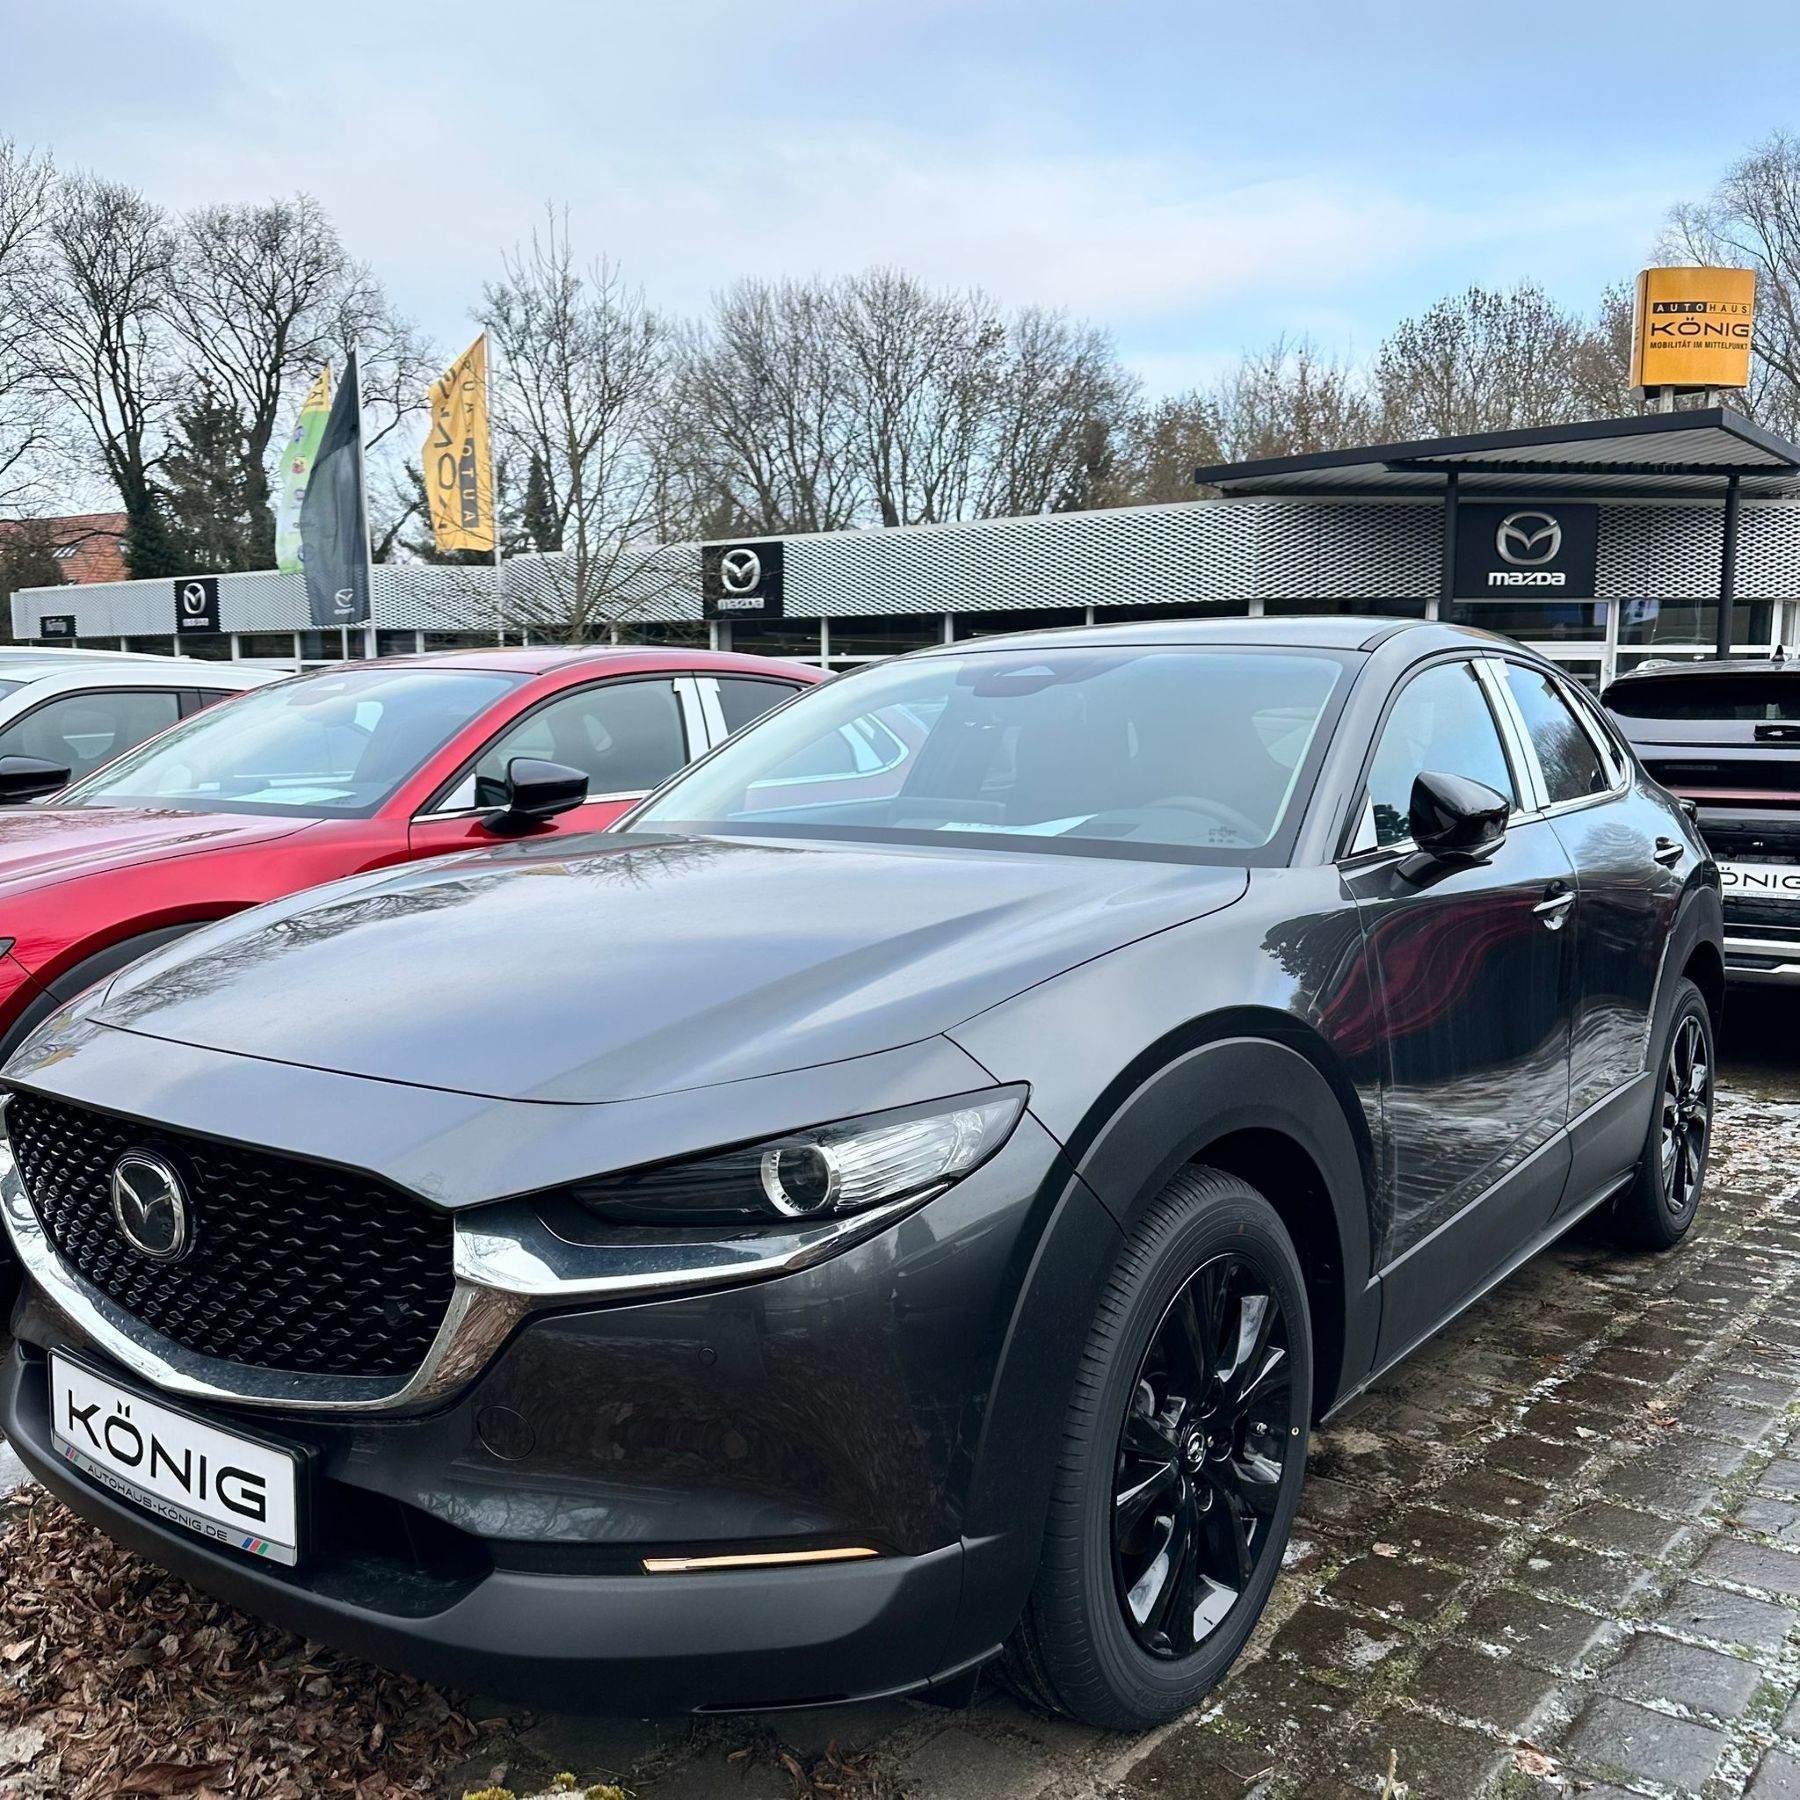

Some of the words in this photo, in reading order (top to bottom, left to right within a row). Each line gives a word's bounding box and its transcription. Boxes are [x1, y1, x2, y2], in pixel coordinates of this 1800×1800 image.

[1655, 303, 1748, 314] AUTOHAUS
[1651, 317, 1749, 337] KÖNIG
[1487, 572, 1566, 585] mazda
[1719, 866, 1800, 889] ÖNIG
[68, 1389, 266, 1523] KÖNIG
[87, 1464, 228, 1542] AUTOHAUS-KÖNIG.DE
